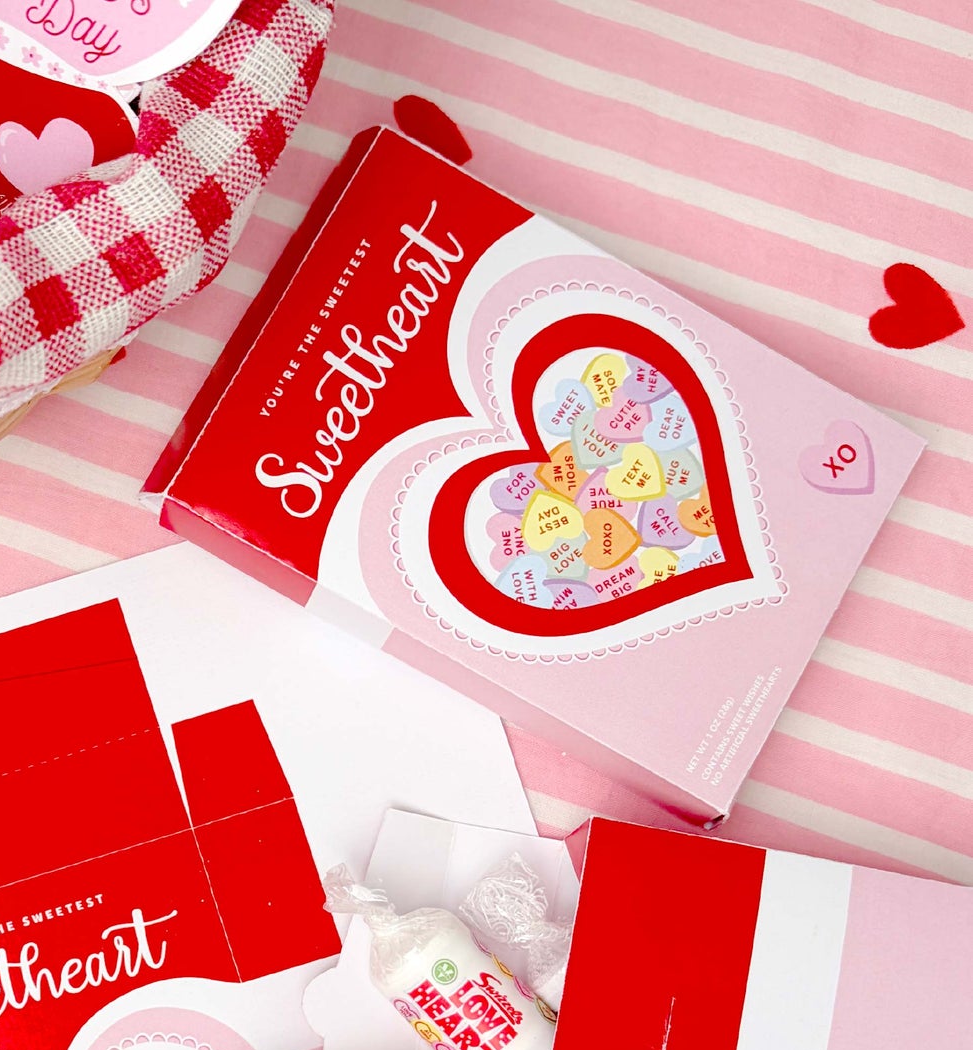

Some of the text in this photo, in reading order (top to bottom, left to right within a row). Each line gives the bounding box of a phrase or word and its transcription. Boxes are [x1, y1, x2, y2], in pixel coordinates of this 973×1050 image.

[260, 238, 372, 418] YOU'RE THE SWEETEST
[255, 200, 464, 518] Sweetheart
[636, 365, 646, 382] MY
[592, 373, 611, 405] MATE
[551, 388, 579, 425] SWEET
[609, 398, 637, 430] CUTIE
[624, 413, 641, 431] PIE
[658, 407, 675, 440] DEAR
[671, 416, 686, 440] ONE
[582, 439, 606, 458] YOU
[822, 444, 857, 479] XO
[506, 471, 527, 494] FOR
[553, 465, 563, 483] ME
[564, 455, 577, 491] SPOIL
[621, 458, 644, 485] TEXT
[636, 473, 652, 488] ME
[665, 460, 679, 486] HUG
[678, 469, 691, 485] ME
[514, 479, 536, 502] YOU
[538, 506, 560, 522] DAY
[590, 499, 623, 509] TRUE
[693, 505, 710, 520] ME
[539, 516, 569, 535] BEST
[650, 520, 667, 538] ME
[655, 508, 680, 536] CALL
[501, 530, 513, 556] ONE
[550, 542, 570, 561] BIG
[603, 522, 612, 555] XOXO
[555, 549, 583, 574] LOVE
[512, 572, 525, 603] LOVE
[524, 570, 537, 601] WITH
[595, 566, 635, 594] DREAM
[611, 582, 632, 598] BIG
[701, 675, 764, 780] CONTAINS SWEET WISHES
[711, 666, 782, 786] NO ARTIFICIAL SWEETHEARTS
[686, 756, 700, 774] NET
[696, 740, 709, 754] WT
[709, 719, 721, 733] OZ
[21, 893, 104, 927] SWEETEST
